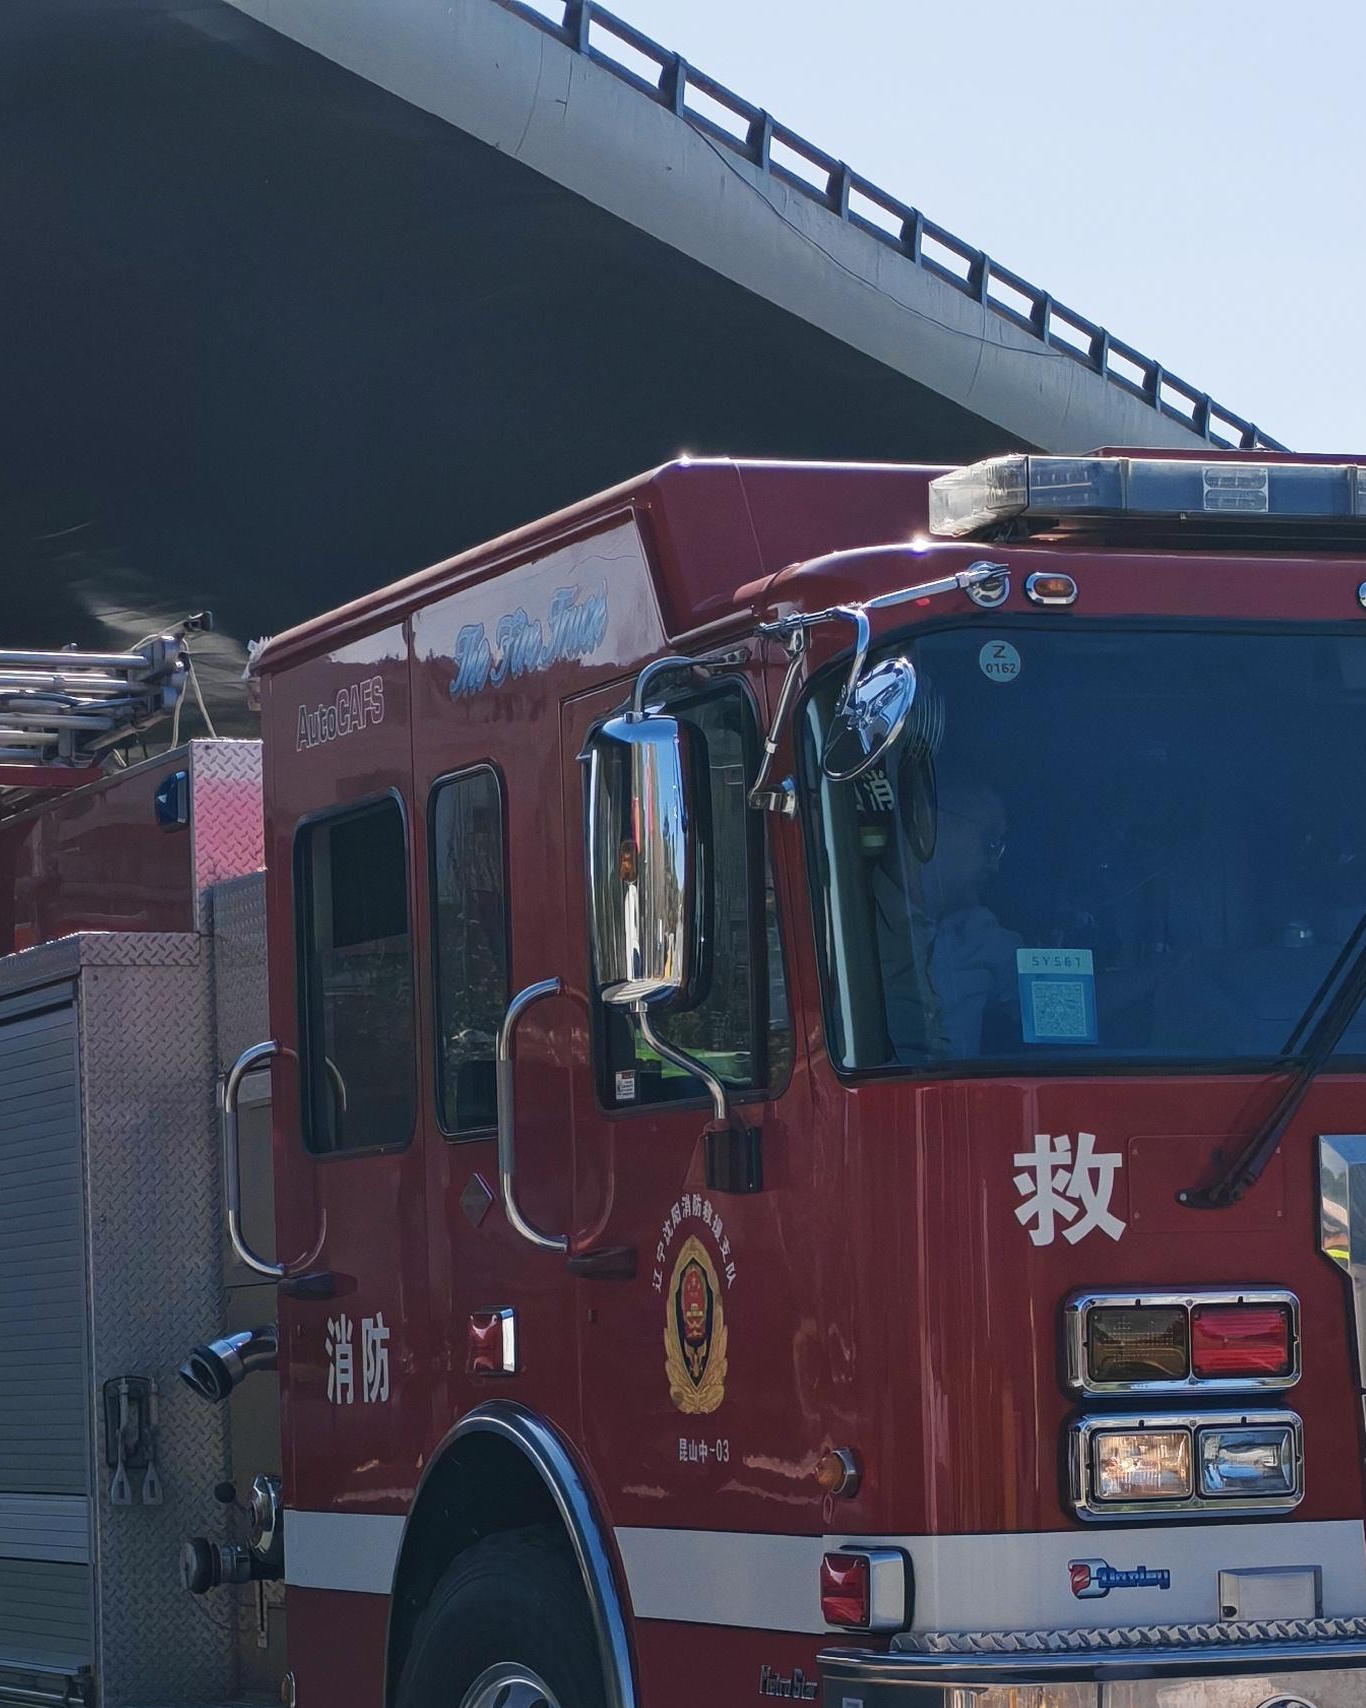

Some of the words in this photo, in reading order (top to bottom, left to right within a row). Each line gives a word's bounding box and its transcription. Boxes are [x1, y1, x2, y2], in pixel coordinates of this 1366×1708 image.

[295, 675, 385, 752] AutoCAFS
[1013, 1132, 1126, 1246] 救
[325, 1311, 390, 1405] 消防
[678, 1438, 731, 1464] 昆山中-03
